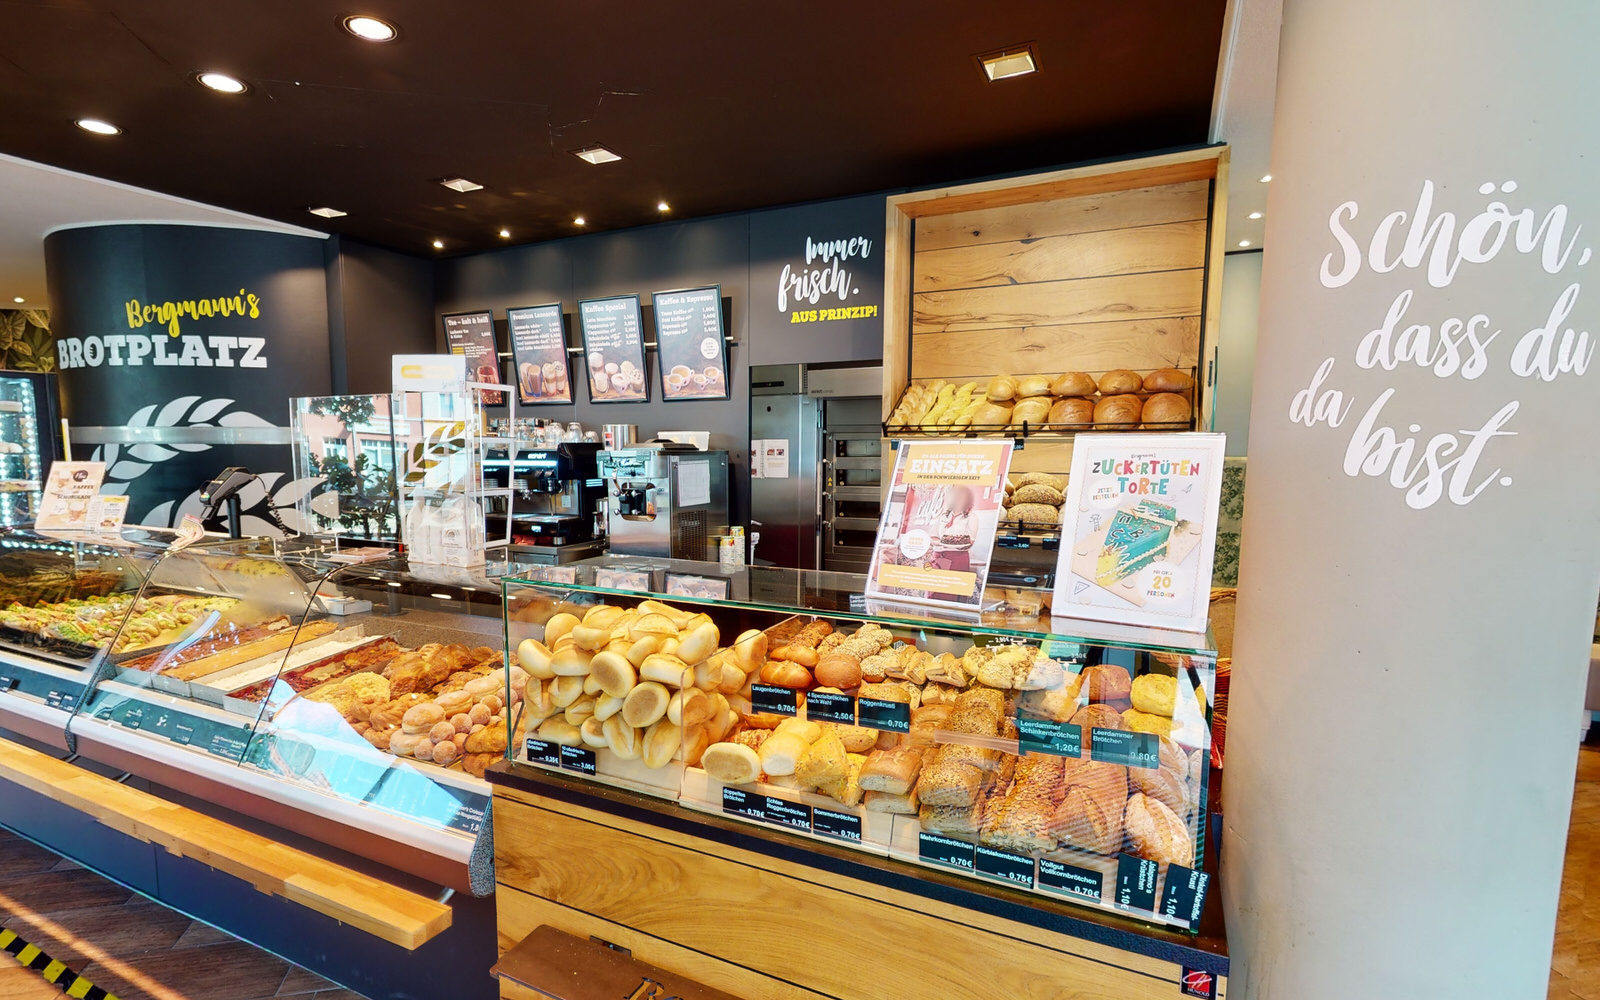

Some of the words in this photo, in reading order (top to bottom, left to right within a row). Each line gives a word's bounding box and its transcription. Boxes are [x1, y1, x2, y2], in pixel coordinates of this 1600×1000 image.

[1319, 180, 1592, 288] Schön,
[806, 236, 872, 265] Immer
[778, 256, 859, 312] frisch.
[125, 288, 260, 338] Bergmann's
[790, 310, 818, 323] AUS
[818, 305, 878, 321] PRINZIP!
[1355, 289, 1501, 380] dass
[1510, 283, 1596, 382] du
[56, 334, 268, 370] BROTPLATZ
[1288, 357, 1354, 428] da
[1343, 387, 1520, 510] bist.
[910, 459, 994, 475] EINSATZ
[1092, 458, 1200, 476] ZUCKERTÜTEN
[1117, 476, 1170, 495] TORTE
[1152, 576, 1172, 589] 20
[1147, 590, 1175, 598] PERSONEN
[751, 685, 791, 696] Laugenbrötchen
[811, 693, 849, 702] Spezialbrötchen
[859, 698, 896, 710] Roggenkrusti
[777, 704, 796, 713] 0,70€
[888, 719, 909, 729] 0,70€
[1020, 720, 1062, 730] Leerdammer
[1020, 727, 1080, 740] Schinkenbrötchen
[1093, 729, 1134, 739] Leerdammer
[1093, 735, 1122, 744] Brötchen
[1055, 743, 1080, 753] 1,20€
[1130, 752, 1157, 762] 0,80€
[723, 794, 745, 803] Brötchen
[766, 798, 783, 806] Echtes
[747, 808, 765, 818] 0,70€
[766, 802, 807, 817] Roggenbrötchen
[813, 808, 858, 823] Sommerbrötchen
[792, 818, 810, 829] 0,70€
[840, 829, 860, 840] 0,70€
[920, 833, 974, 850] Mehrkornbrötchen
[950, 856, 973, 868] 0,70€
[977, 847, 1034, 866] Kürbiskornbrötchen
[1040, 859, 1064, 872] Vollgut
[1009, 872, 1033, 884] 0,75€
[1040, 866, 1097, 885] Vollkornbrötchen
[1188, 870, 1200, 889] Krusti
[1074, 886, 1100, 898] 0,70€
[1120, 887, 1131, 910] 1,10€
[1165, 897, 1178, 921] 1,10€
